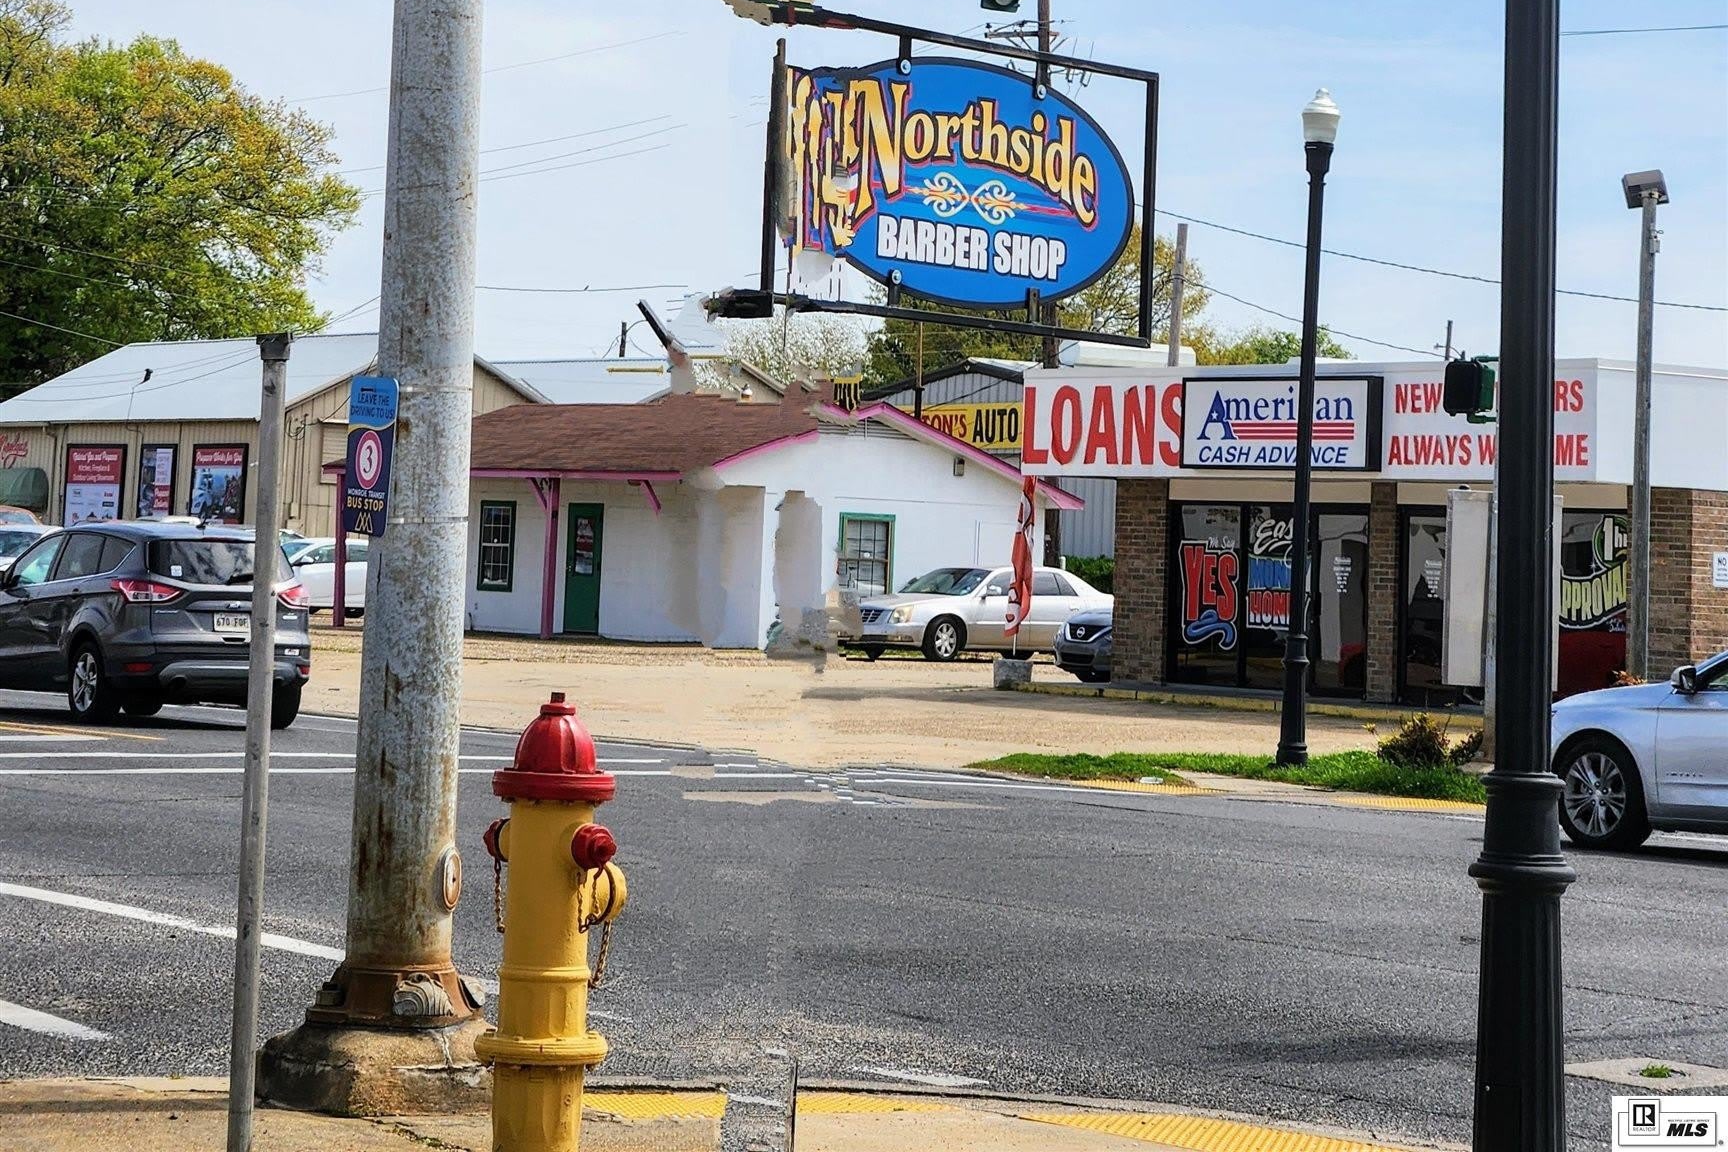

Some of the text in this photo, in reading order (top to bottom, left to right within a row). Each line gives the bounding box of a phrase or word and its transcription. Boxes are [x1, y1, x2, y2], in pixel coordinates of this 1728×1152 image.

[851, 78, 1097, 225] Northside
[877, 215, 1066, 281] BARBER SHOP
[350, 405, 375, 418] DRIVING
[376, 408, 385, 418] TO
[358, 393, 390, 406] LEAVE THE
[1197, 386, 1354, 440] Amerian
[1395, 383, 1443, 414] NEW
[972, 408, 1019, 443] AUTO
[1022, 383, 1183, 468] LOANS
[363, 445, 373, 473] 3
[1199, 446, 1349, 464] CASH ADVNCE
[1389, 434, 1472, 465] ALWAYS
[347, 488, 385, 499] MONROE TRANSIT
[347, 496, 384, 512] BUS STOP
[1248, 556, 1293, 590] MON
[1717, 556, 1727, 567] NO
[1183, 545, 1236, 621] YES
[1561, 560, 1628, 621] PPROVA
[216, 617, 230, 626] 670
